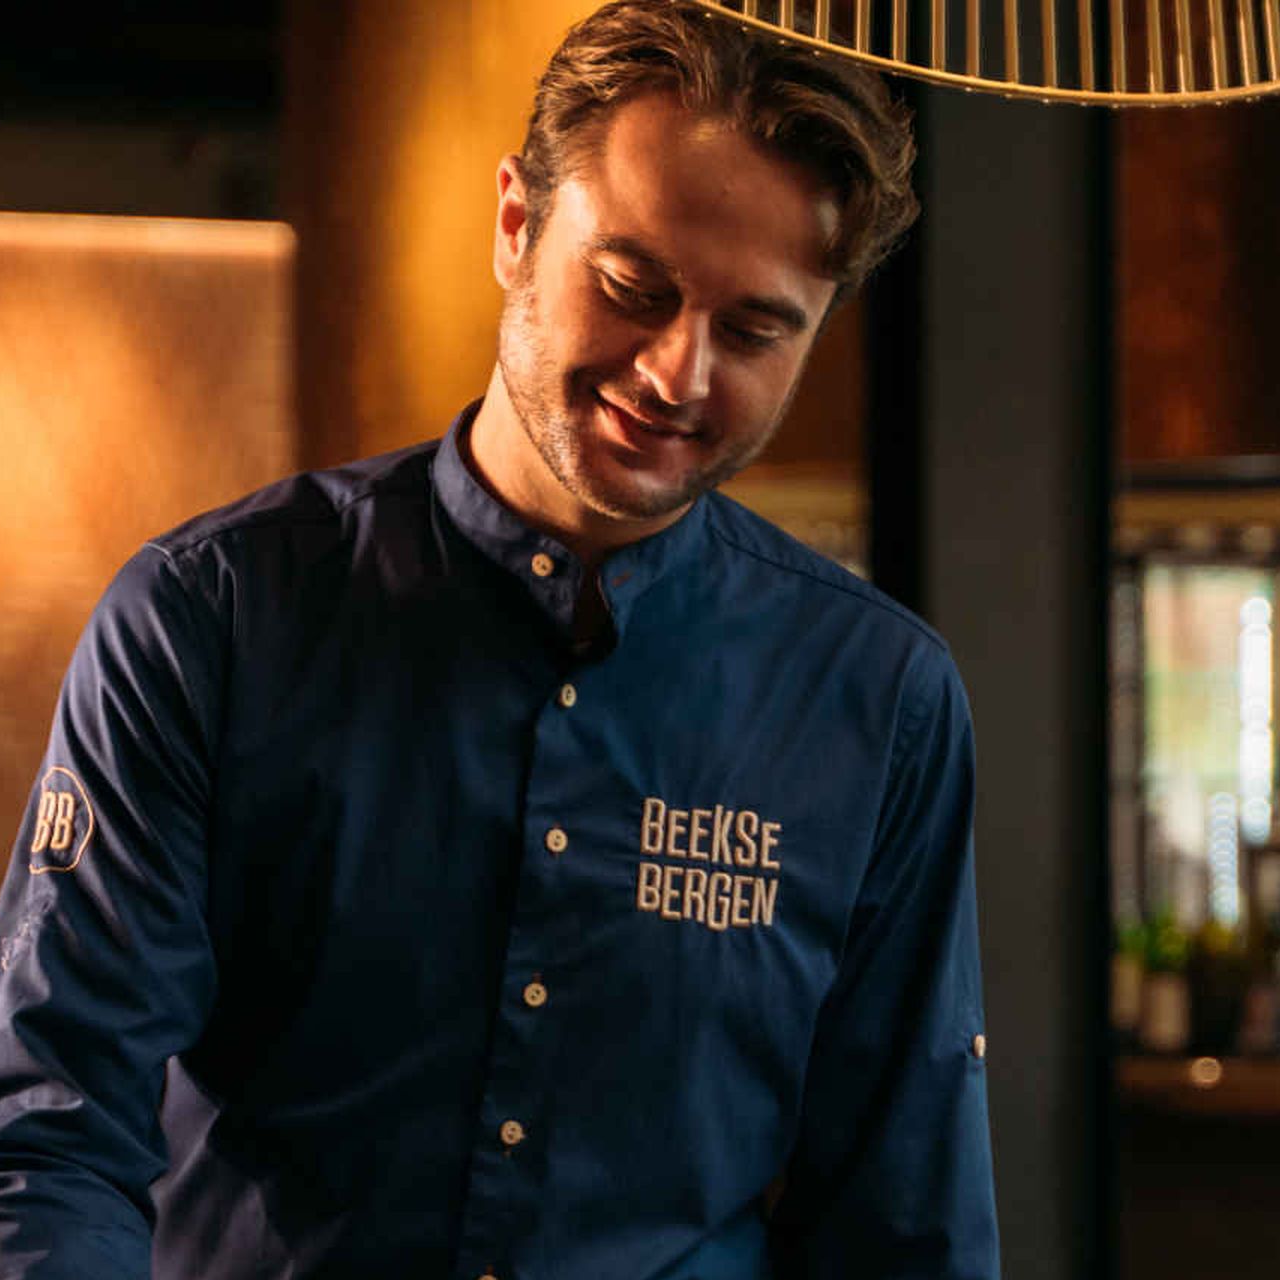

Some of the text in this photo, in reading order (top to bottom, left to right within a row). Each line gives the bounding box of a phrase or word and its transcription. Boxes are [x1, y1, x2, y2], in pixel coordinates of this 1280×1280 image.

[31, 791, 75, 853] BB
[641, 797, 782, 871] BEEKSE
[637, 861, 779, 931] BERGEN
